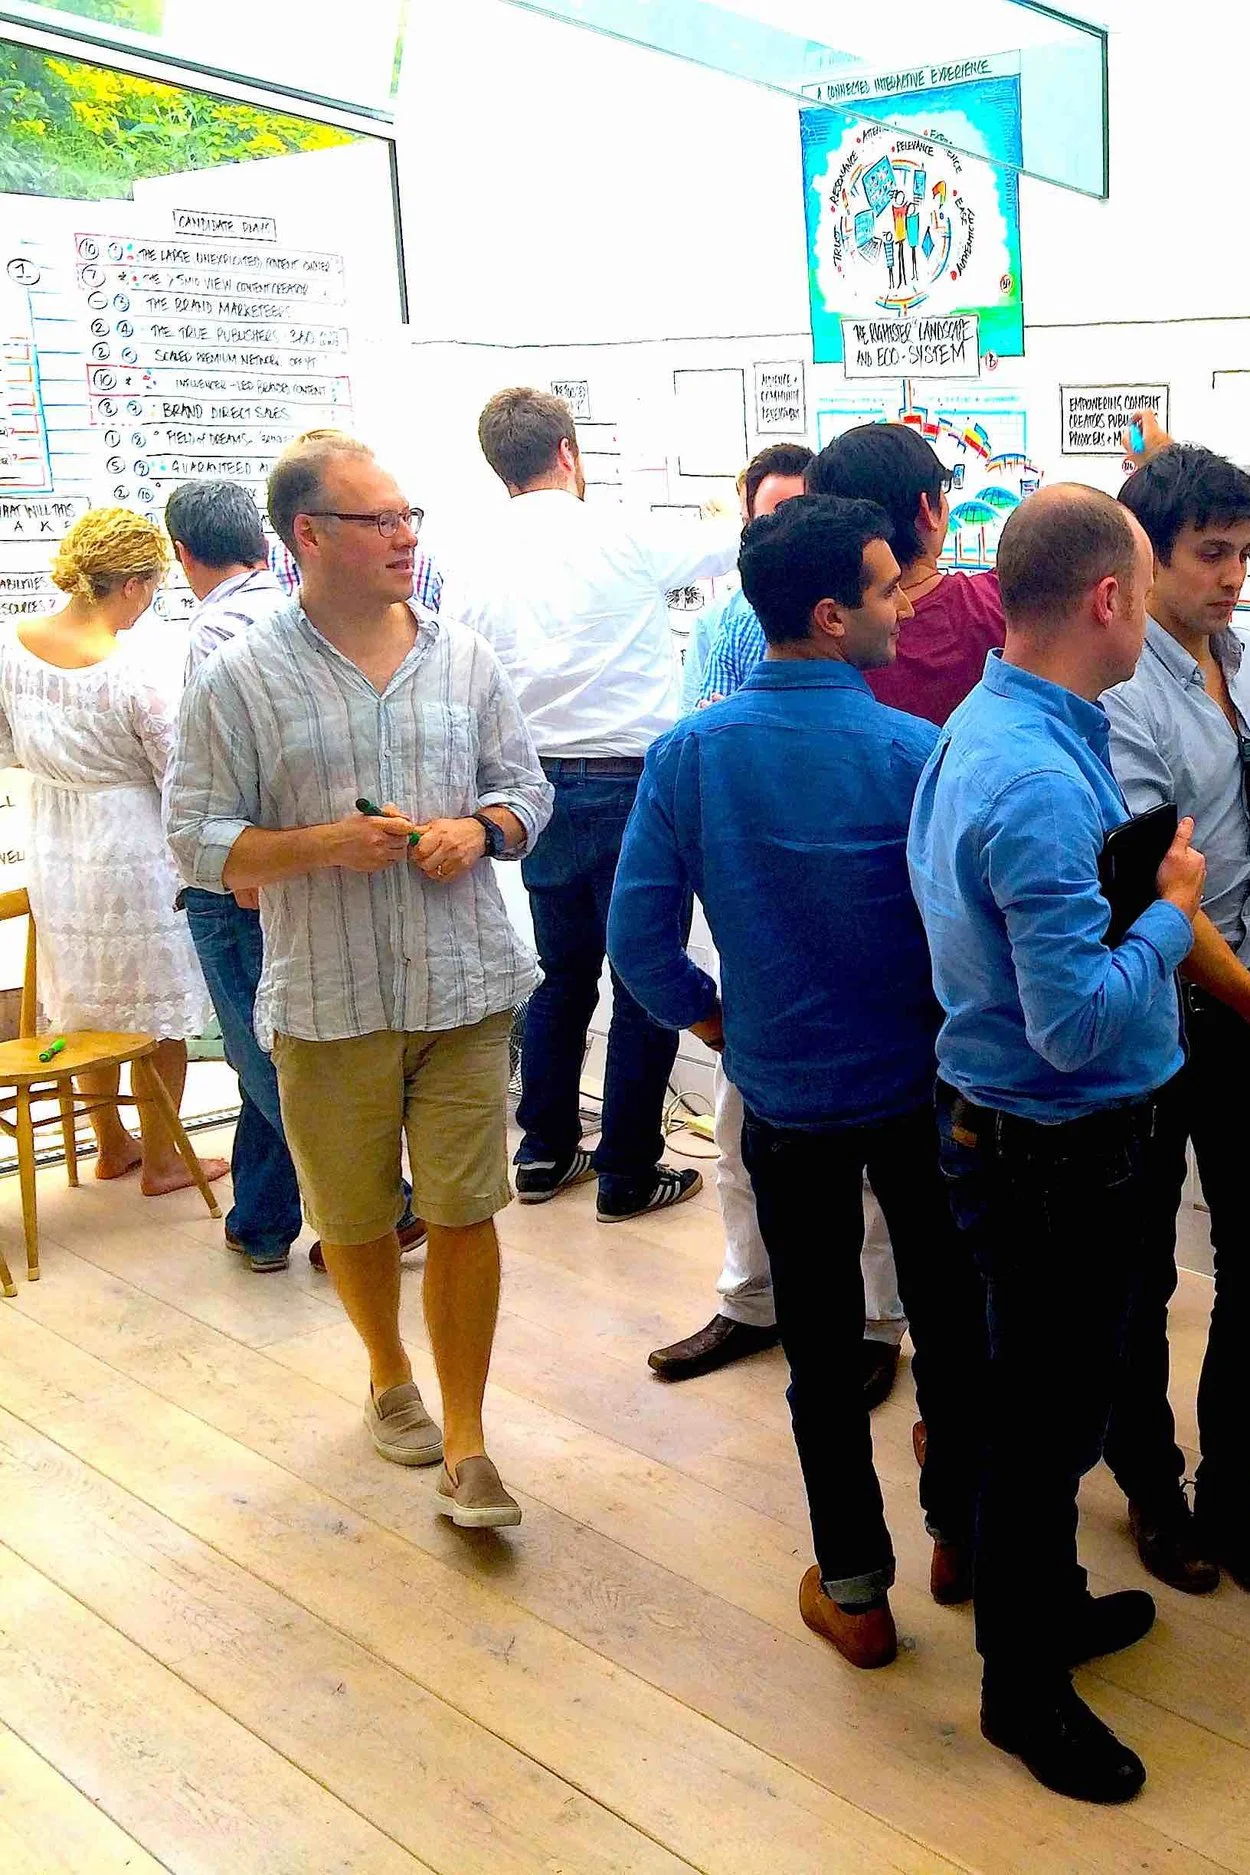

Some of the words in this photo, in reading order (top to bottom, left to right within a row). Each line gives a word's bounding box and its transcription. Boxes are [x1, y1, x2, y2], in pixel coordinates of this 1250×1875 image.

[151, 324, 176, 338] THE
[163, 402, 203, 419] BRAND
[211, 406, 251, 420] DIRECT
